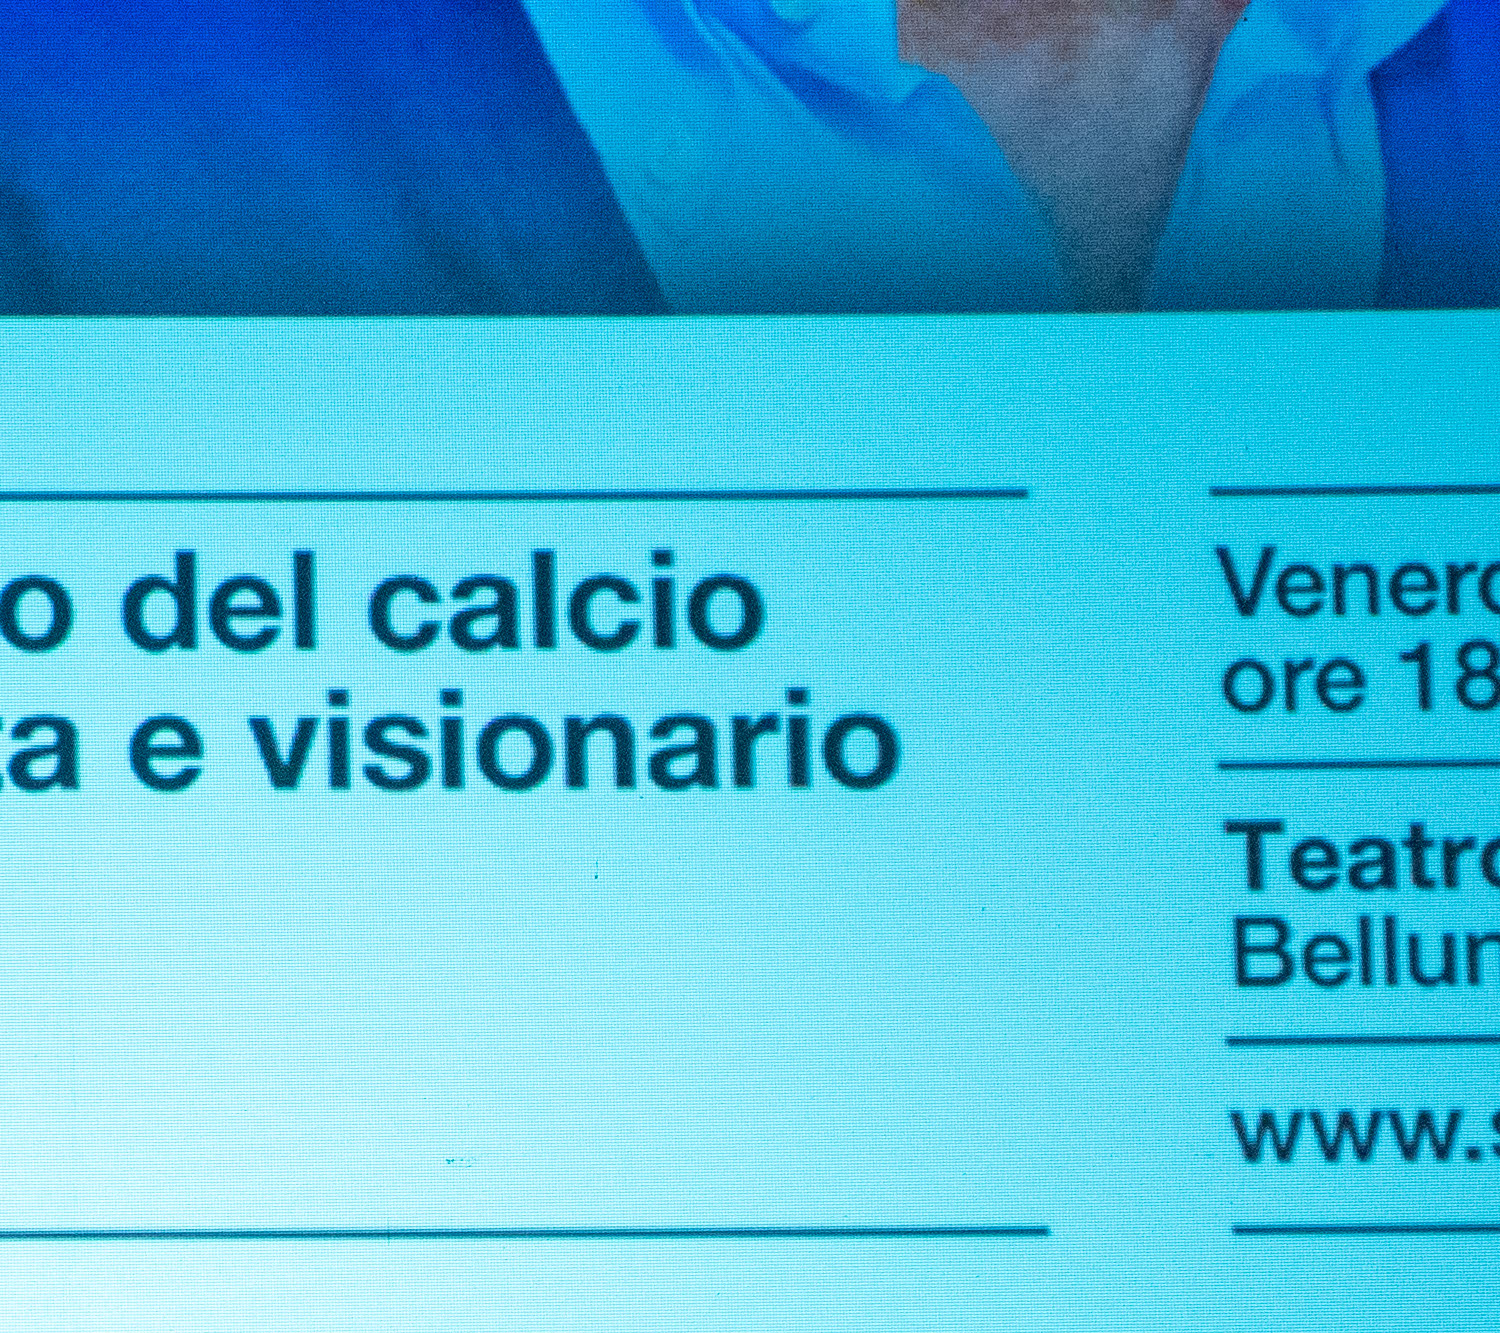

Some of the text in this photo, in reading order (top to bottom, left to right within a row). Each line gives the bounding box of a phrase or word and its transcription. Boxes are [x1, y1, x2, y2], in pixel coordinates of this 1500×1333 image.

[122, 550, 317, 653] del
[368, 550, 766, 653] calcio
[1221, 656, 1367, 715] ore
[129, 714, 204, 792] e
[249, 687, 901, 792] visionario
